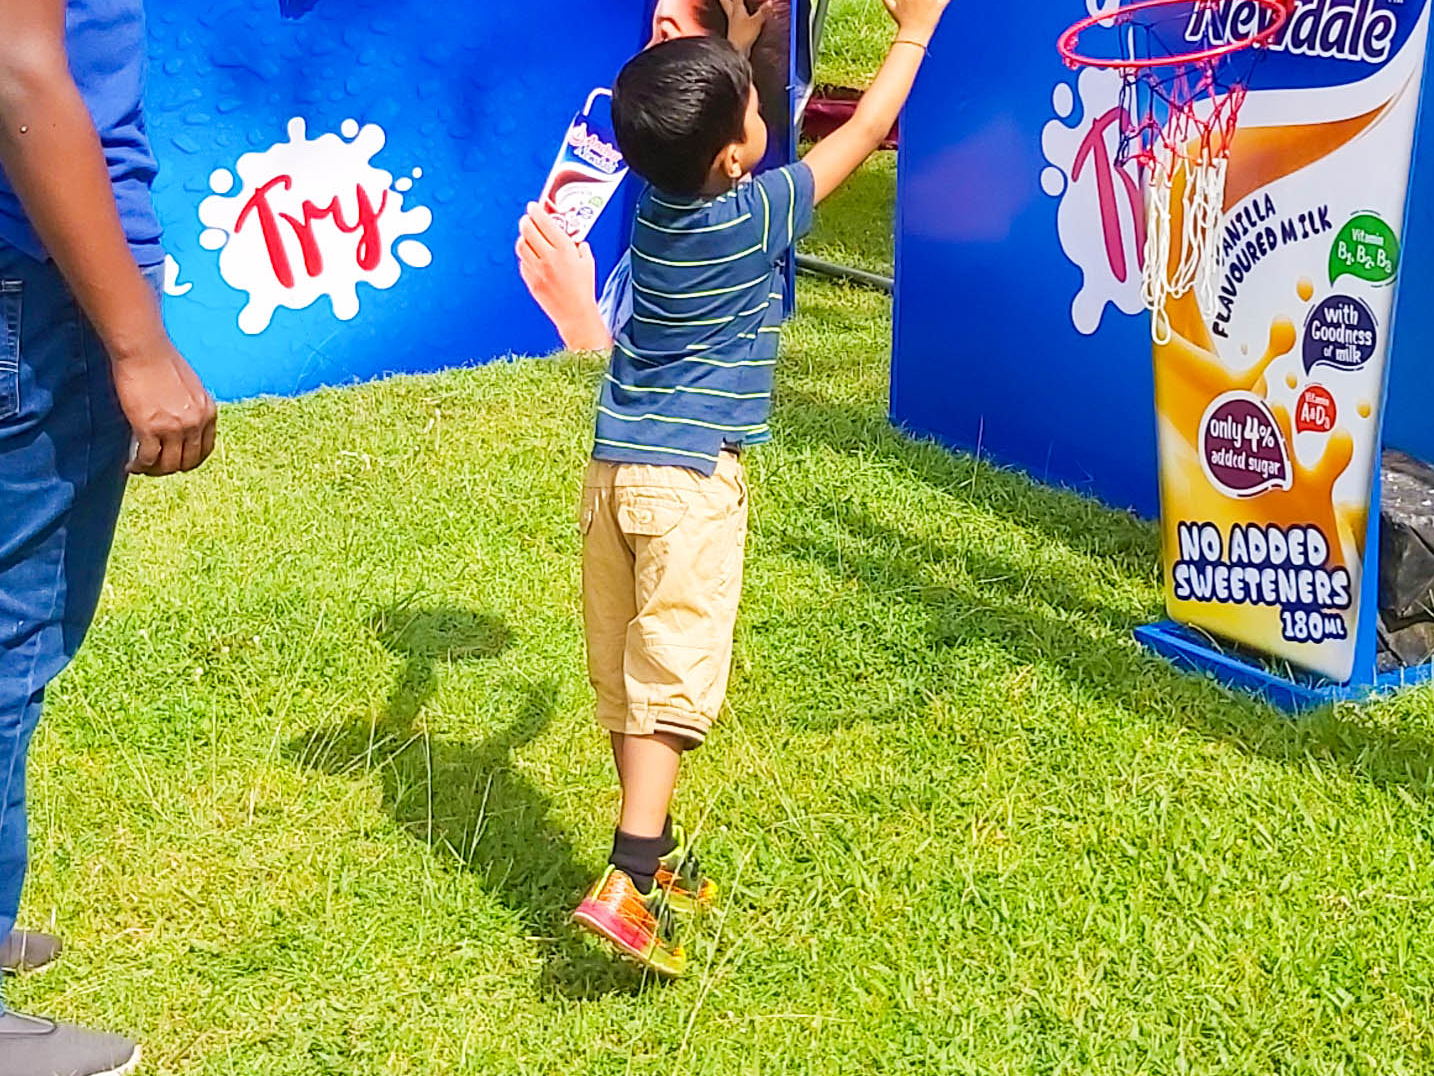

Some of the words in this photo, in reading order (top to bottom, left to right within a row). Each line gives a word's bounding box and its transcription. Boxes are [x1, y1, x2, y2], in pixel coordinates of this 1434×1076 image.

[234, 175, 387, 289] Try
[1216, 193, 1276, 266] ANILLA
[1212, 227, 1277, 338] FLAVOURED
[1281, 204, 1333, 245] MILK
[1312, 320, 1372, 345] Goodness
[1324, 304, 1358, 325] with
[1323, 345, 1334, 357] of
[1335, 344, 1362, 363] milk
[1210, 415, 1242, 448] only
[1244, 415, 1275, 452] 4%
[1211, 448, 1246, 470] added
[1248, 457, 1281, 478] sugar
[1180, 524, 1221, 561] NO
[1231, 527, 1327, 566] ADDED
[1174, 564, 1349, 605] SWEETENERS
[1282, 610, 1345, 639] 180ML
